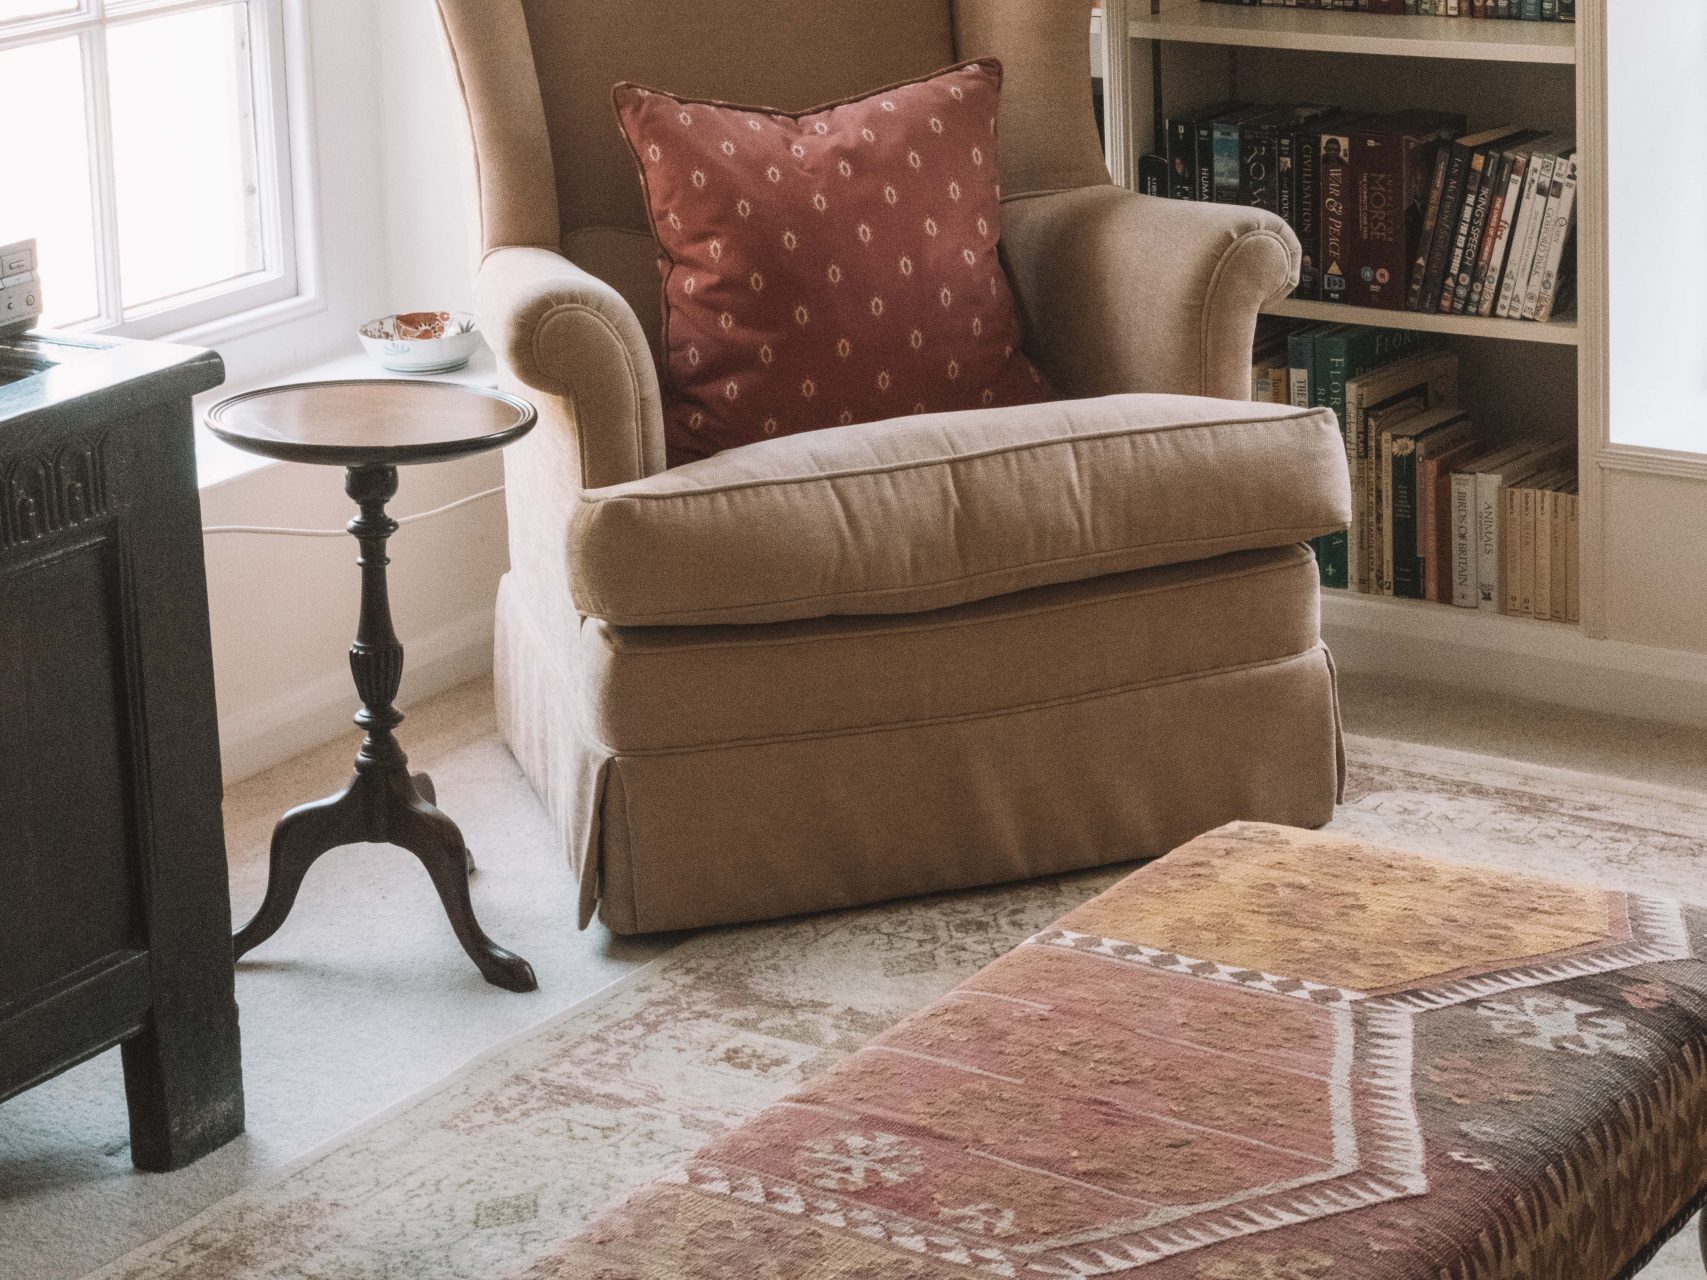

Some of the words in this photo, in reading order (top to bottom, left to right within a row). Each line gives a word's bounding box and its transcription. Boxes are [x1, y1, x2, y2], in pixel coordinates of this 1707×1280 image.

[1329, 168, 1342, 196] WAR
[1325, 198, 1343, 215] &
[1370, 174, 1386, 241] MORSE
[1328, 217, 1343, 259] PEACE
[1464, 228, 1481, 266] SPEECH
[1456, 492, 1468, 524] BIRDS
[1457, 526, 1468, 542] OF
[1484, 502, 1494, 555] ANIMALS
[1458, 543, 1468, 587] BRITAIN
